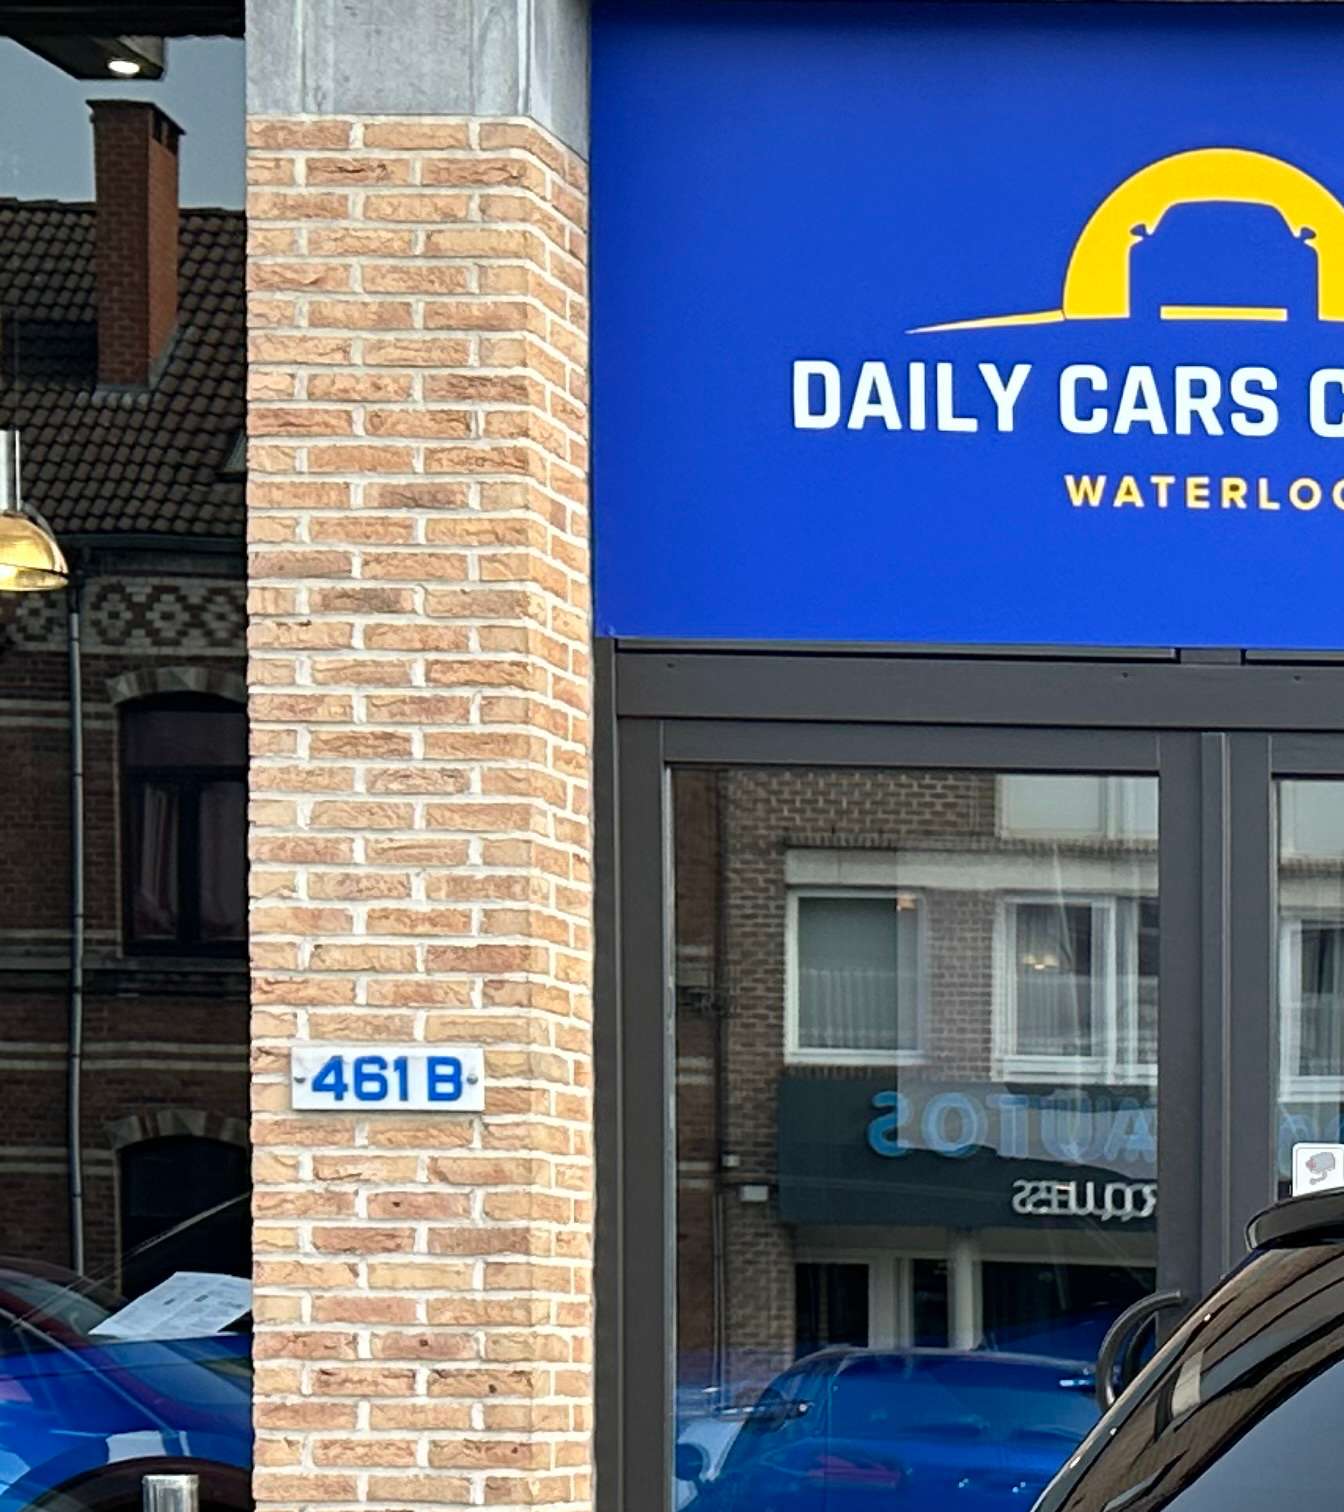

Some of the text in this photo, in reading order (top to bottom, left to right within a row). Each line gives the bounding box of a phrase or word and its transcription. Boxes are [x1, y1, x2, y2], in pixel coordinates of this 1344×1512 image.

[793, 360, 1032, 433] DAILY
[1059, 364, 1279, 437] CARS
[311, 1055, 463, 1102] 461 B
